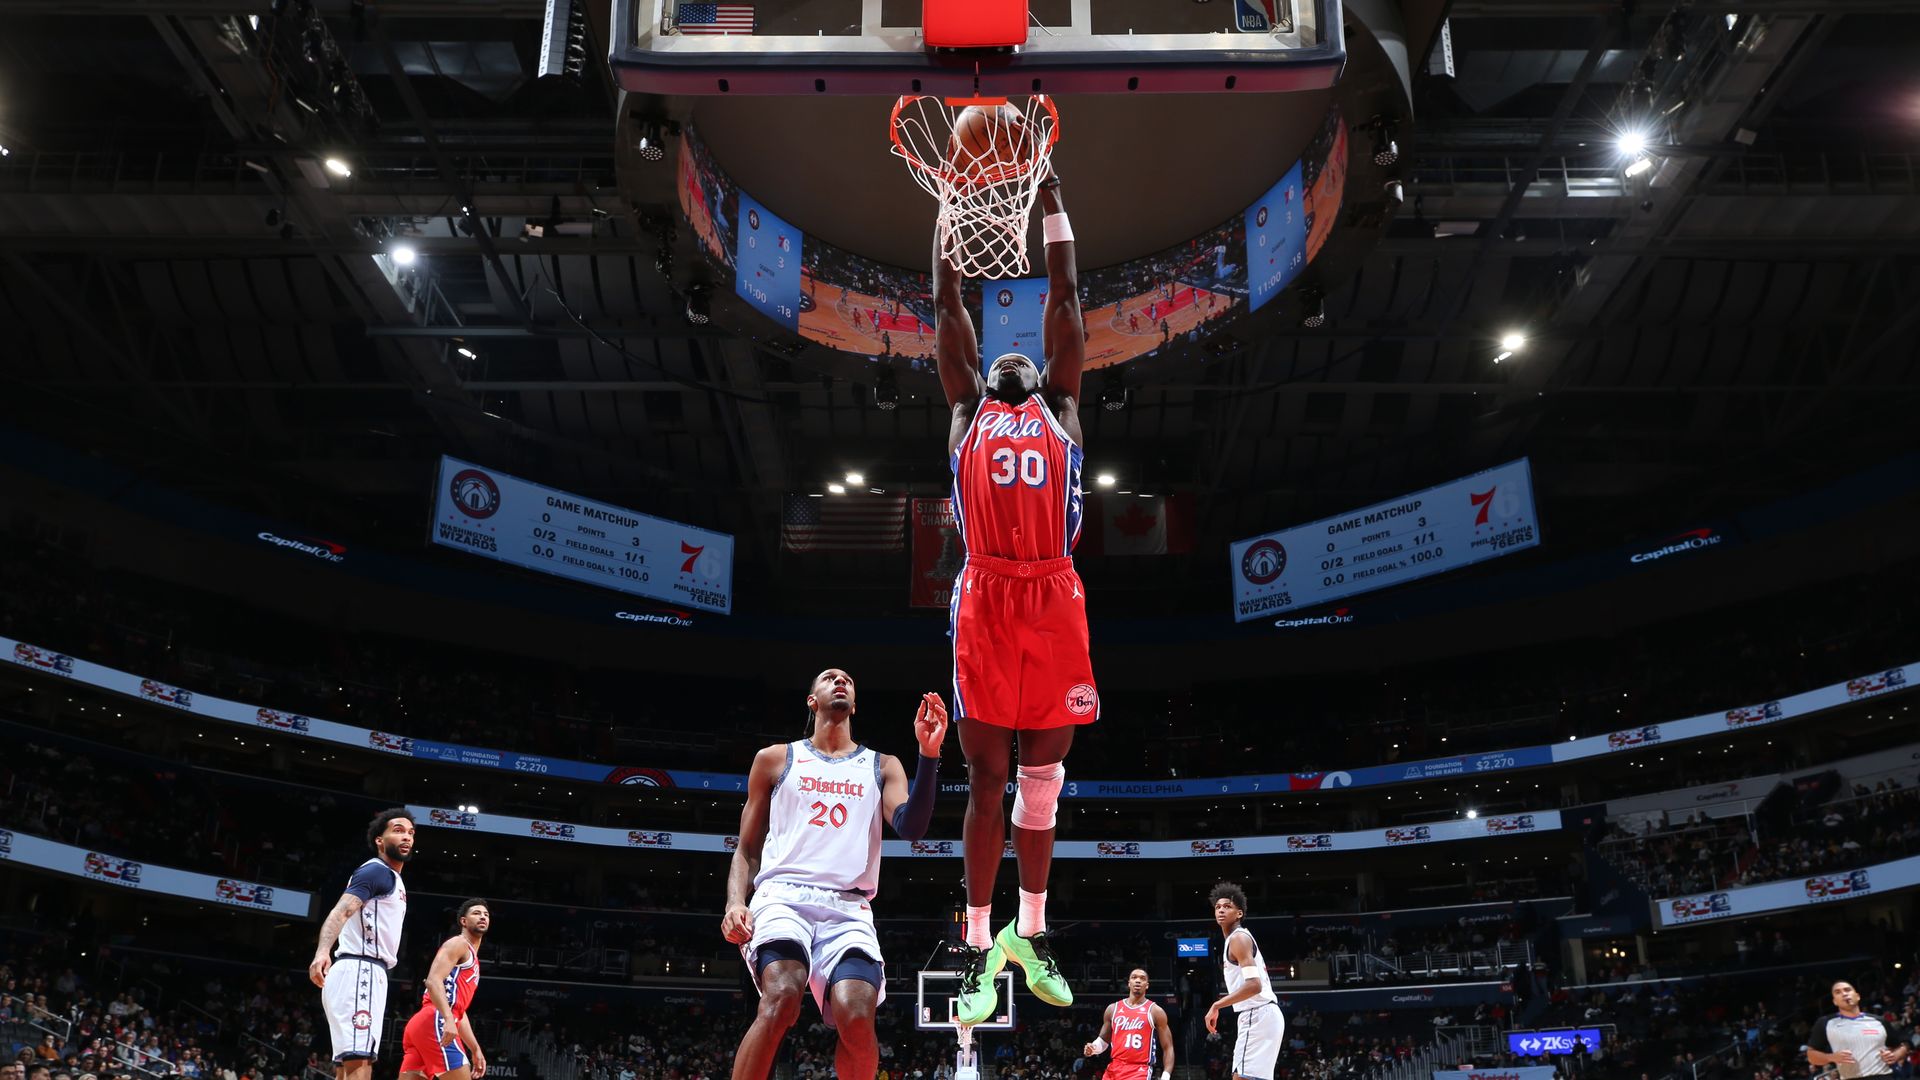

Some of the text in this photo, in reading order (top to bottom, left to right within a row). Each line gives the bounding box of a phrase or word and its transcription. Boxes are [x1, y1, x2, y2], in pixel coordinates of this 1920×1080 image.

[1241, 15, 1262, 28] NBA
[1286, 210, 1292, 224] 3
[749, 236, 756, 249] 0
[778, 235, 790, 253] 76
[1259, 235, 1266, 247] 0
[778, 256, 784, 268] 3
[744, 279, 767, 303] 11:00
[1257, 271, 1282, 296] 11:00
[1000, 314, 1009, 326] 0
[973, 410, 1044, 452] Phila
[991, 447, 1047, 488] 30
[547, 496, 639, 528] GAME MATCHUP
[917, 502, 954, 513] STANLE
[921, 514, 956, 526] CHAMP
[1328, 500, 1422, 535] GAME MATCHUP
[440, 522, 496, 543] WASHINGTON
[542, 513, 640, 547] 0 POINTS 3
[1326, 517, 1426, 552] 0 POINTS 3
[1471, 525, 1532, 548] PHILADELPHIA
[440, 528, 498, 552] WIZARDS
[533, 527, 645, 564] 0/2 FIELD GOALS 1/1
[1490, 531, 1534, 550] 76ERS
[1321, 531, 1435, 570] 0/2 FIELD GOALS 1/1
[532, 544, 554, 558] 0.0
[562, 555, 585, 566] FIELD
[586, 561, 606, 572] GOAL
[619, 567, 649, 582] 100.0
[1323, 573, 1344, 586] 0.0
[1353, 568, 1375, 579] FIELD
[1376, 563, 1397, 574] GOAL
[1410, 547, 1443, 564] 100.0
[674, 583, 727, 600] PHILADELPHIA
[934, 590, 949, 604] 20
[1239, 591, 1289, 607] WASHINGTON
[690, 593, 727, 608] 76ERS
[1240, 596, 1292, 615] WIZARDS
[462, 751, 500, 760] FOUNDATION
[480, 759, 500, 767] RAFFLE
[1476, 757, 1514, 770] $2,270
[515, 761, 548, 773] $2,270
[1425, 761, 1462, 771] FOUNDATION
[703, 780, 709, 788] 0
[736, 782, 742, 790] 7
[798, 776, 865, 797] District
[941, 784, 970, 792] 1st QTR
[1068, 782, 1078, 796] 3
[1098, 784, 1184, 794] PHILADELPHIA
[808, 801, 848, 828] 20
[1114, 1015, 1145, 1034] Phila
[1124, 1033, 1142, 1049] 16
[1542, 1035, 1592, 1050] ZKsyc
[486, 1065, 518, 1077] ENTAL
